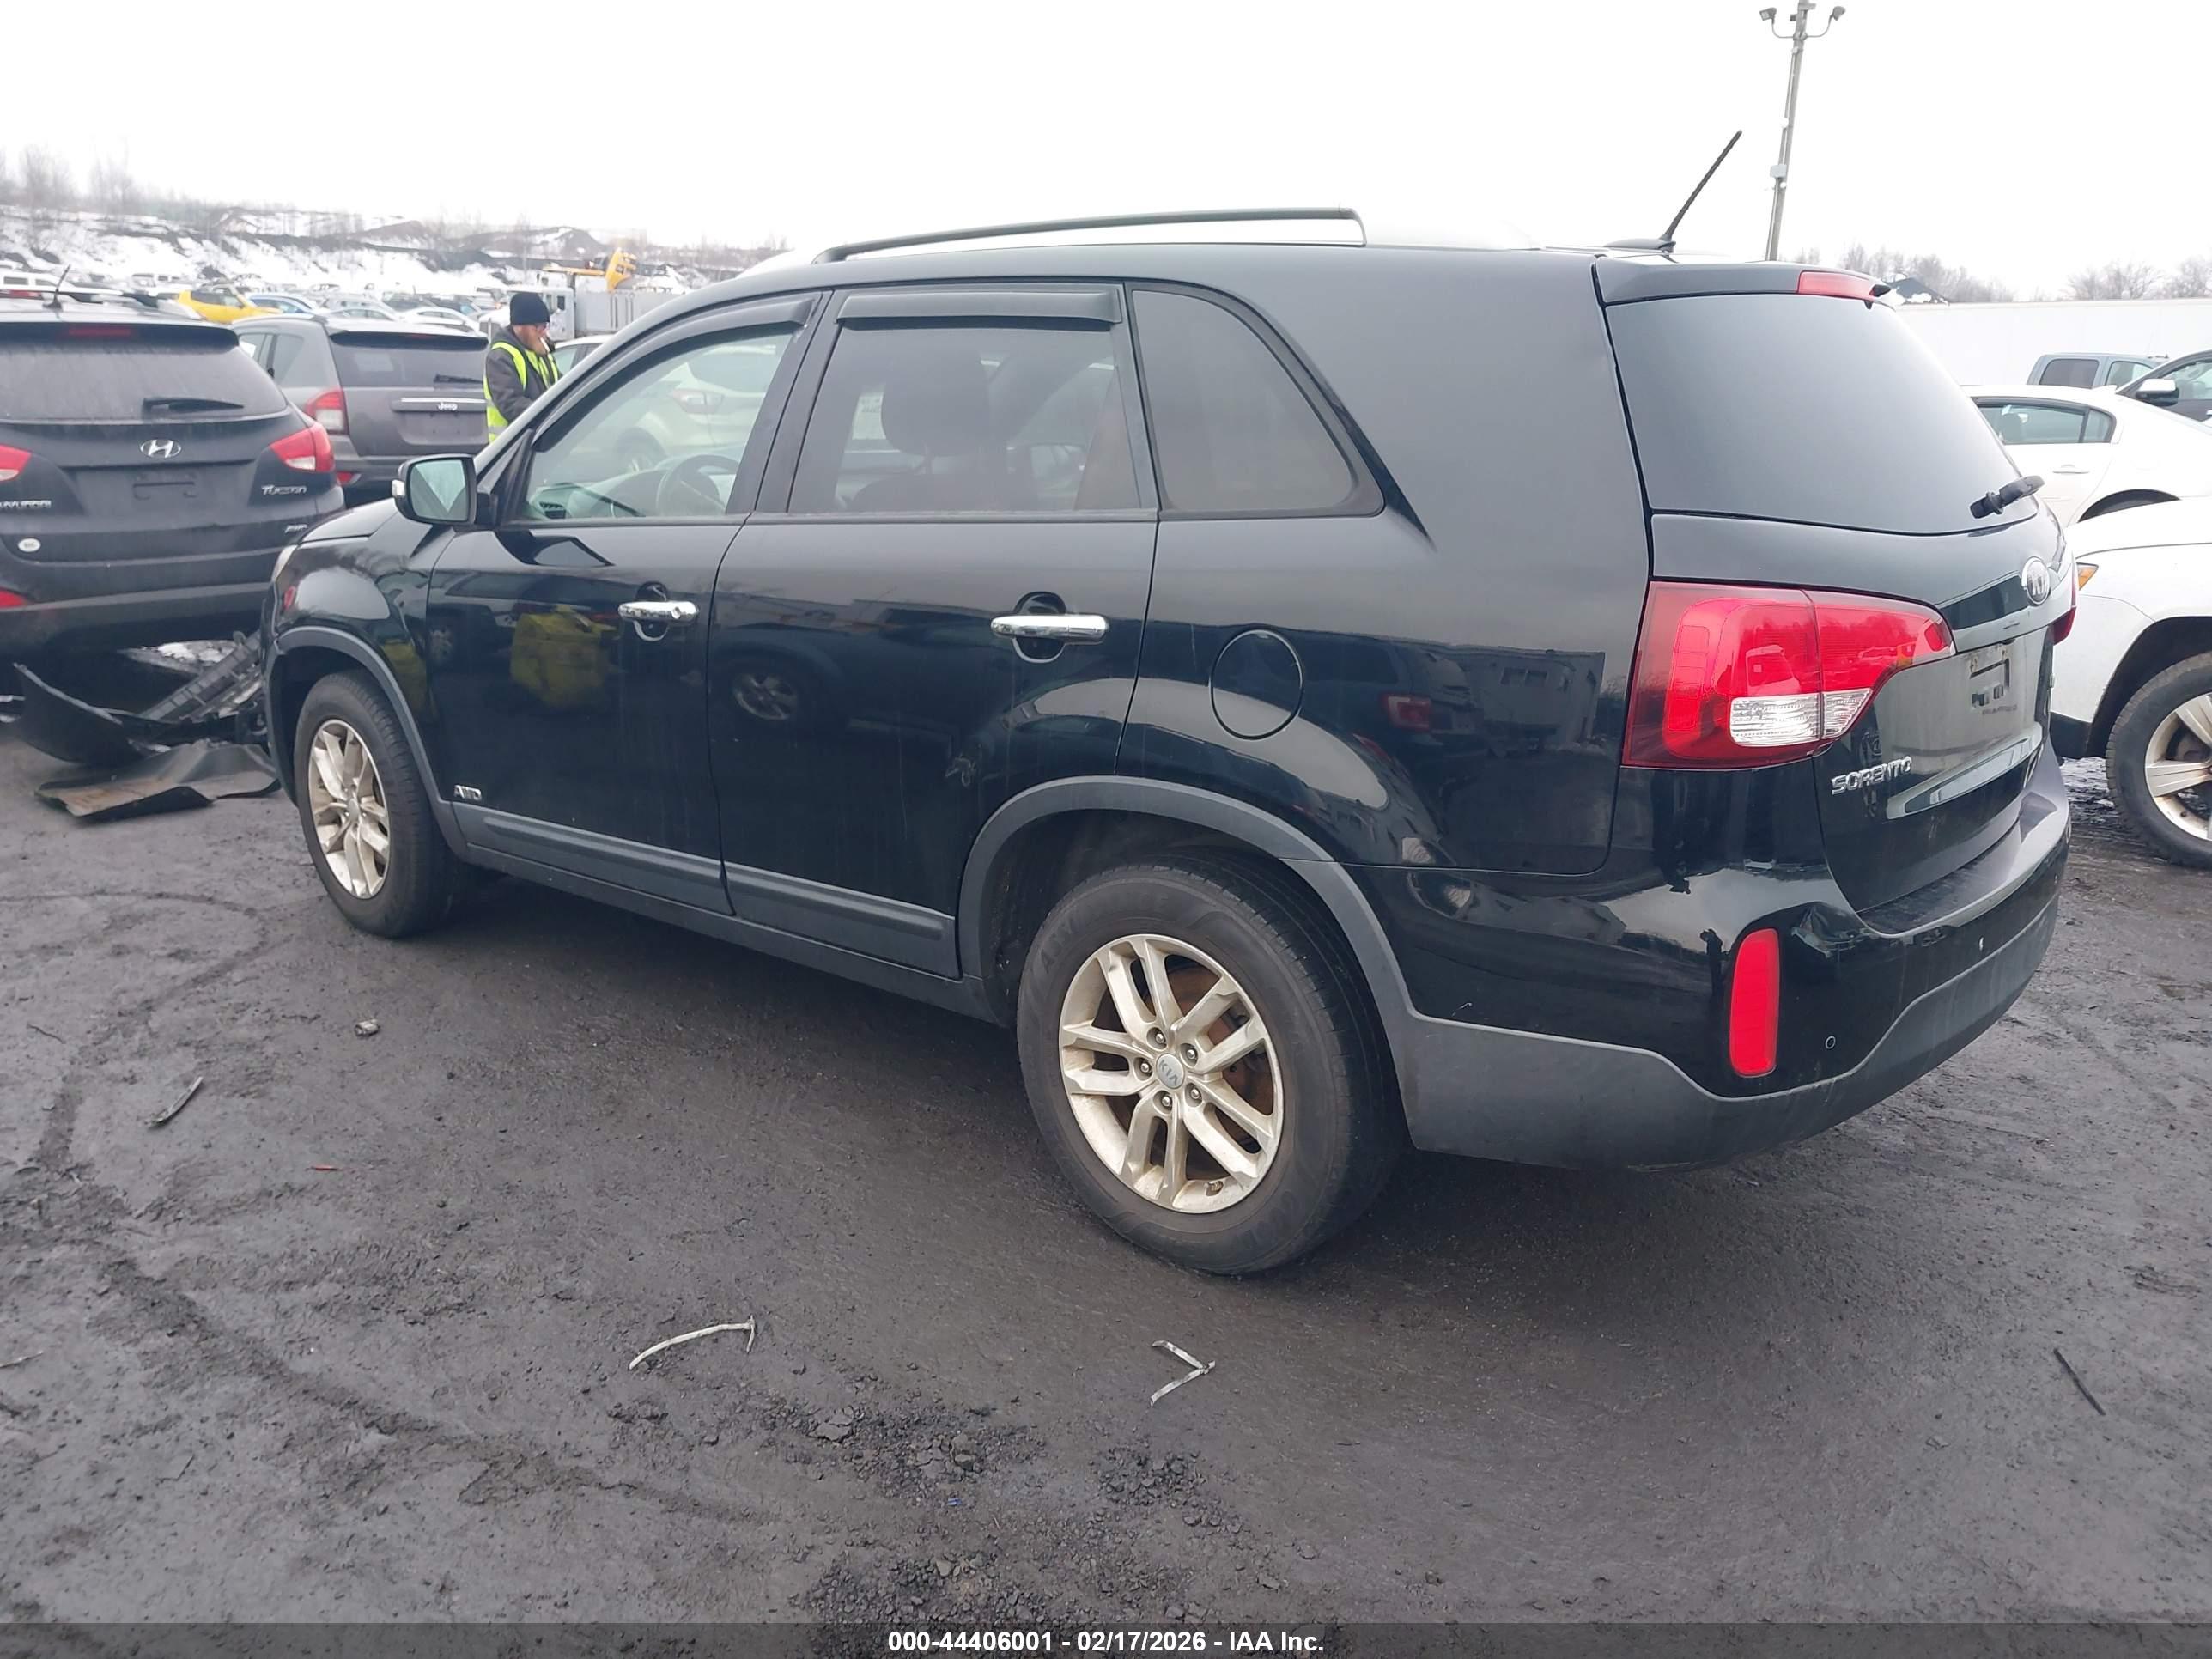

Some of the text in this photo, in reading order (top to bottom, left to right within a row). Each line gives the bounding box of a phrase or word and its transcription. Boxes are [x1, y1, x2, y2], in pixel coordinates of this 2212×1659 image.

[438, 402, 458, 411] Jeep
[1832, 756, 1911, 795] SORENTO
[1159, 1059, 1179, 1086] KIA
